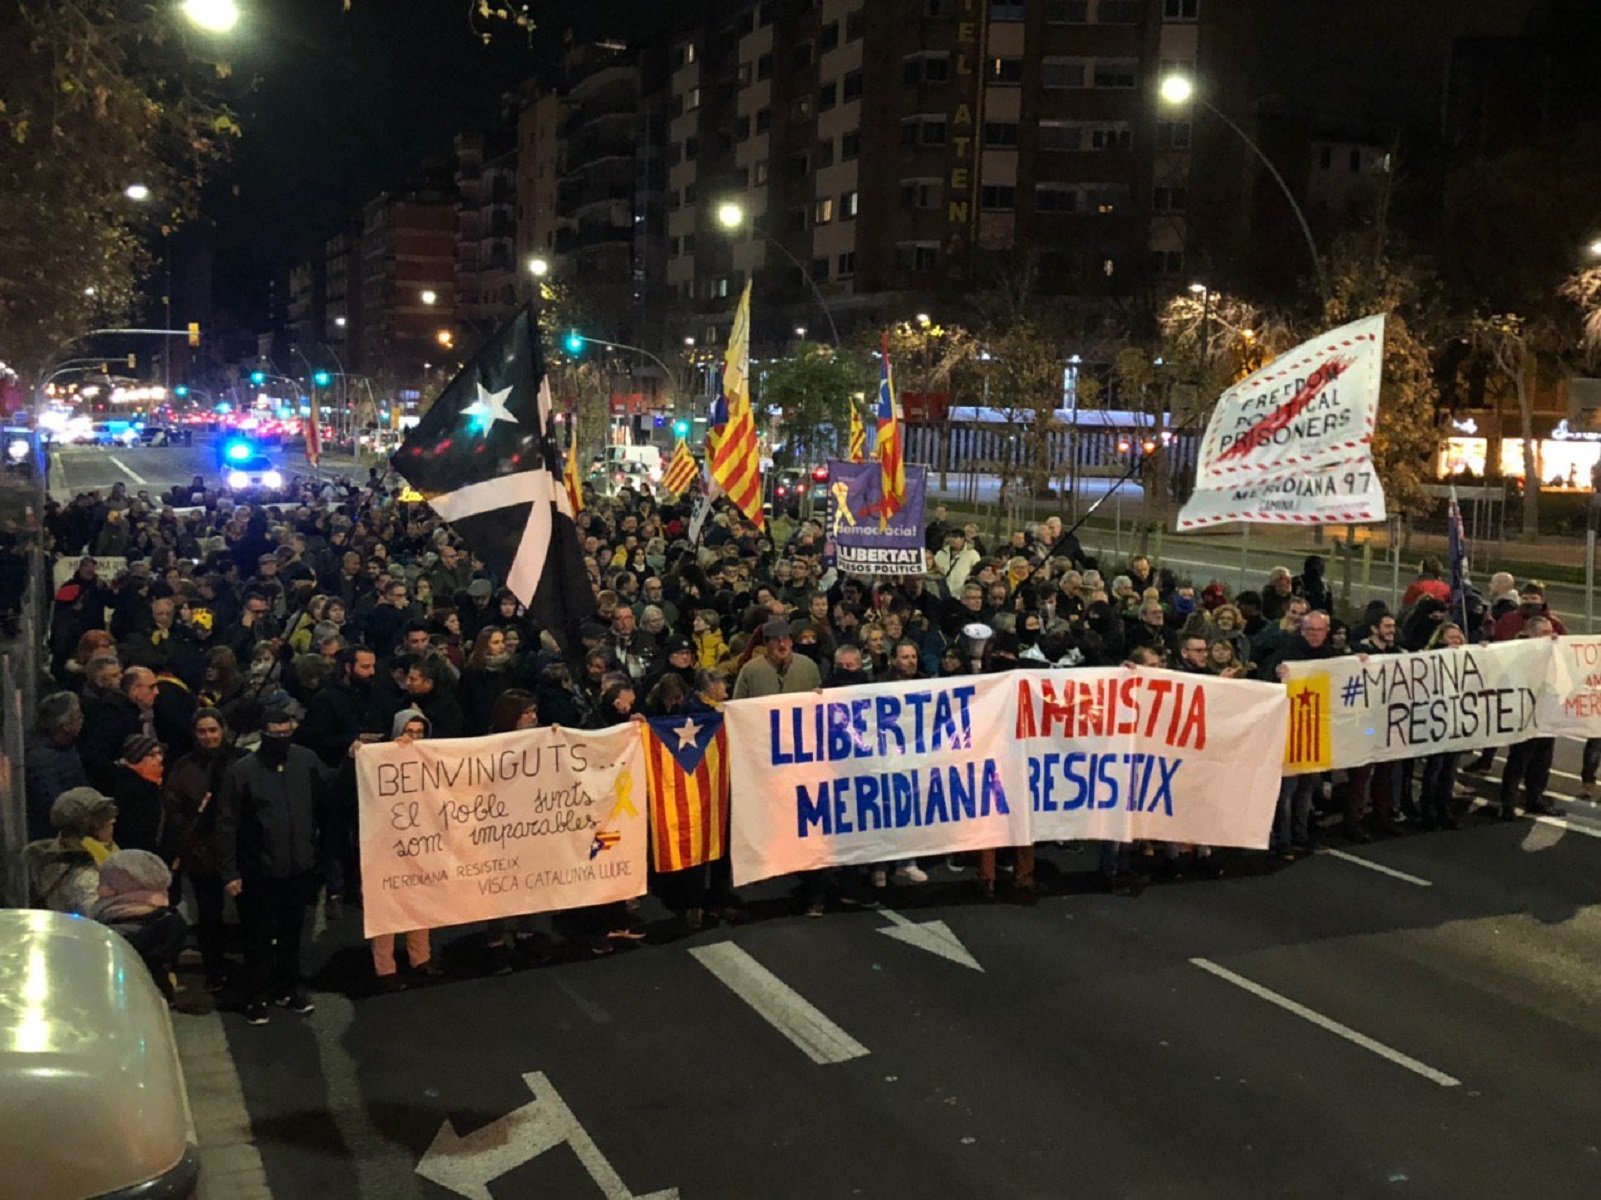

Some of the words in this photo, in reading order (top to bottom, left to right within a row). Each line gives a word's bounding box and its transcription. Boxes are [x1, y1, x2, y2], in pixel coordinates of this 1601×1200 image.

[1235, 389, 1340, 428] POITICAL
[1220, 408, 1351, 452] PRISONERS
[1343, 472, 1371, 494] 97
[1341, 650, 1485, 708] #MARINA
[770, 685, 976, 766] LLIBERTAT
[1016, 676, 1207, 750] AMNISTIA
[391, 801, 420, 831] El
[796, 758, 1010, 838] MERIDIANA
[392, 832, 443, 858] som
[469, 809, 602, 850] imparables
[381, 869, 449, 891] MERIDIANA
[456, 856, 521, 878] RESISTEIX
[478, 874, 520, 896] VISCA
[525, 863, 597, 890] CATALUNYA
